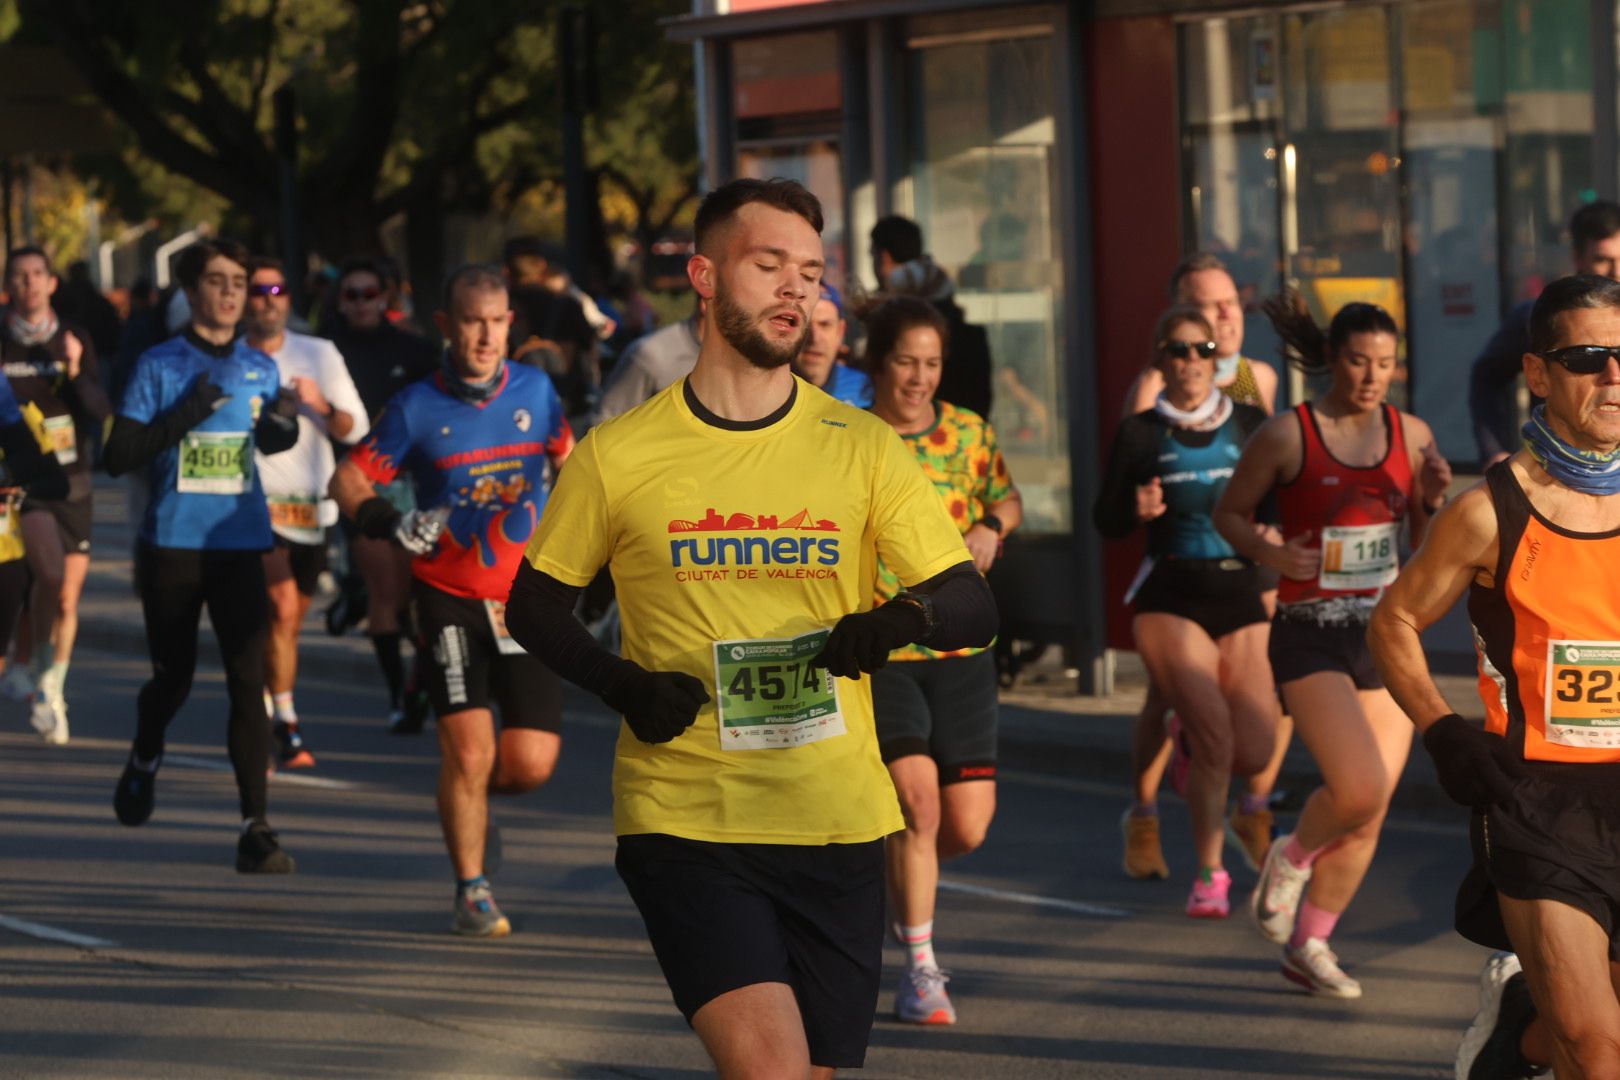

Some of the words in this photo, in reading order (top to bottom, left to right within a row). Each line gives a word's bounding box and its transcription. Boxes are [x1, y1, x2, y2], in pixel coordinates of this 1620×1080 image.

[670, 537, 840, 567] runners
[1355, 538, 1389, 560] 118
[675, 570, 730, 582] CIUTAT
[737, 569, 758, 579] DE
[767, 567, 838, 580] VALÈNCIA
[728, 660, 820, 702] 4574
[1557, 669, 1620, 704] 32
